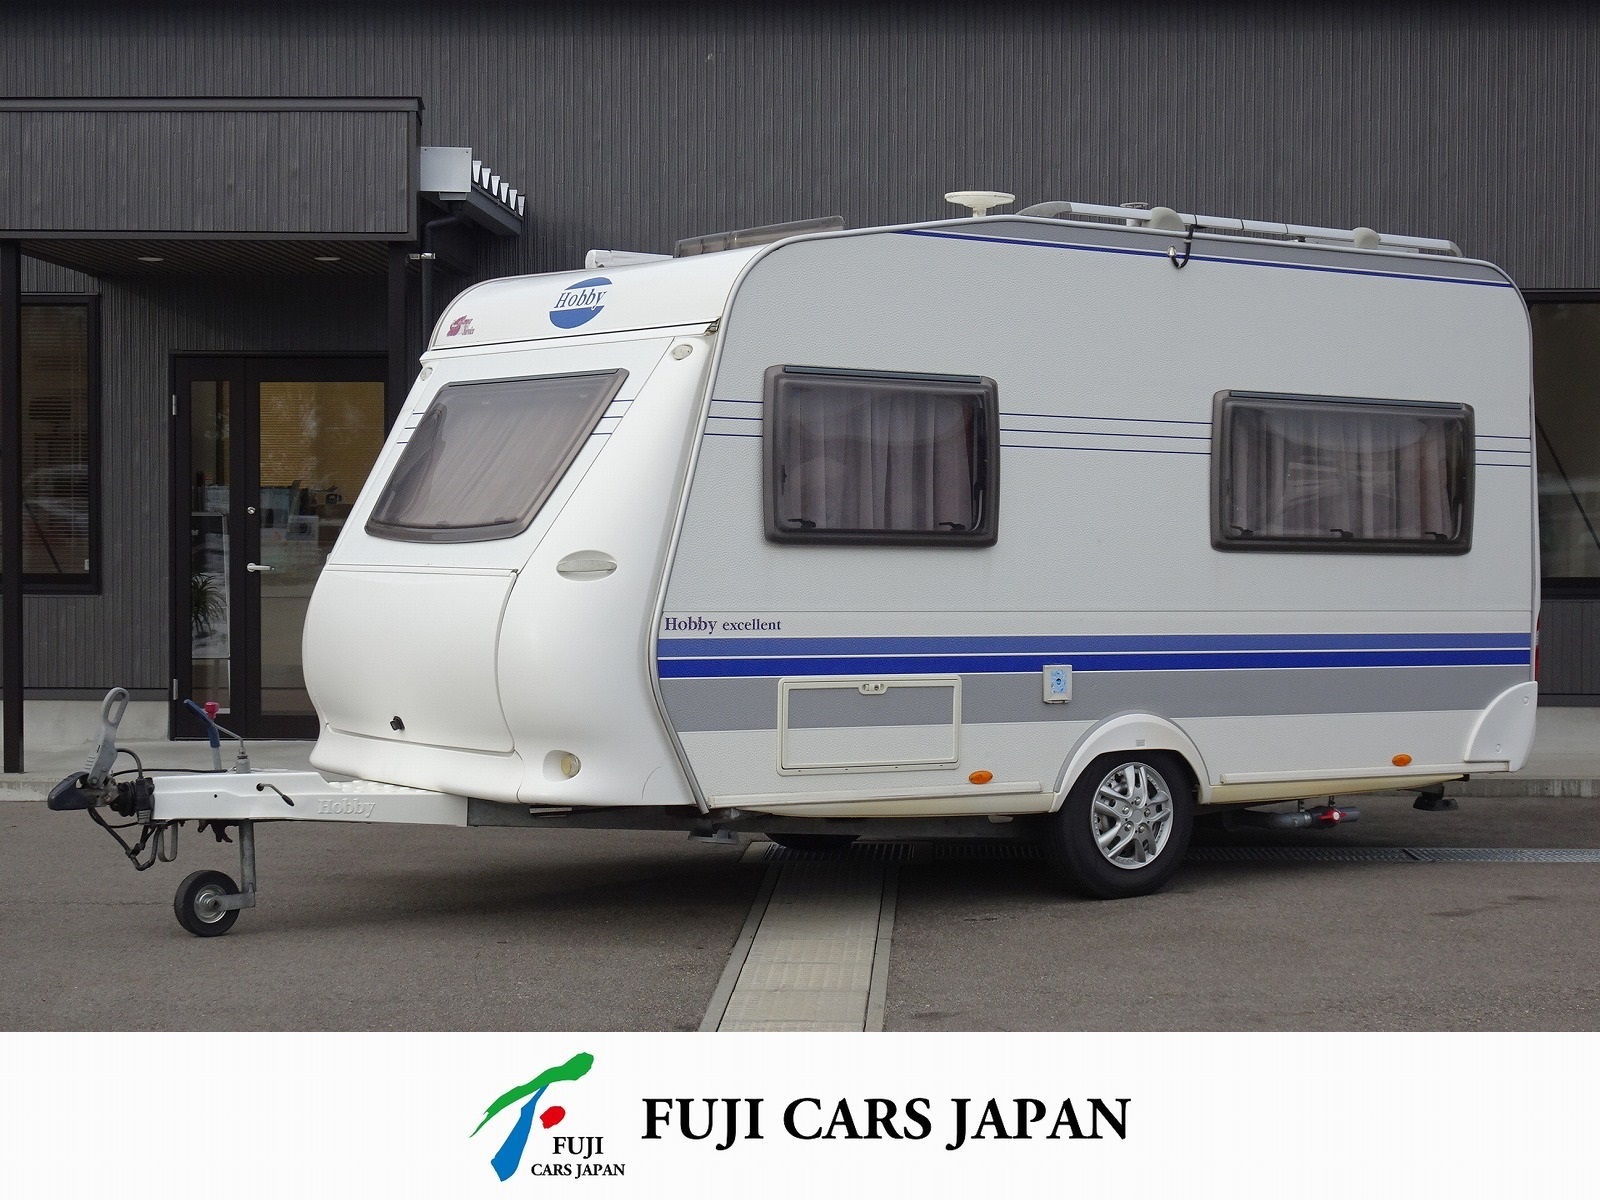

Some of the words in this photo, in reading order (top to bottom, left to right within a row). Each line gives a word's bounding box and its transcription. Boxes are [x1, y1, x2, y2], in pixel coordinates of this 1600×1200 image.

[554, 288, 608, 309] Hobby
[664, 616, 717, 634] Hobby
[722, 618, 782, 631] excellent
[318, 798, 376, 818] Hobby
